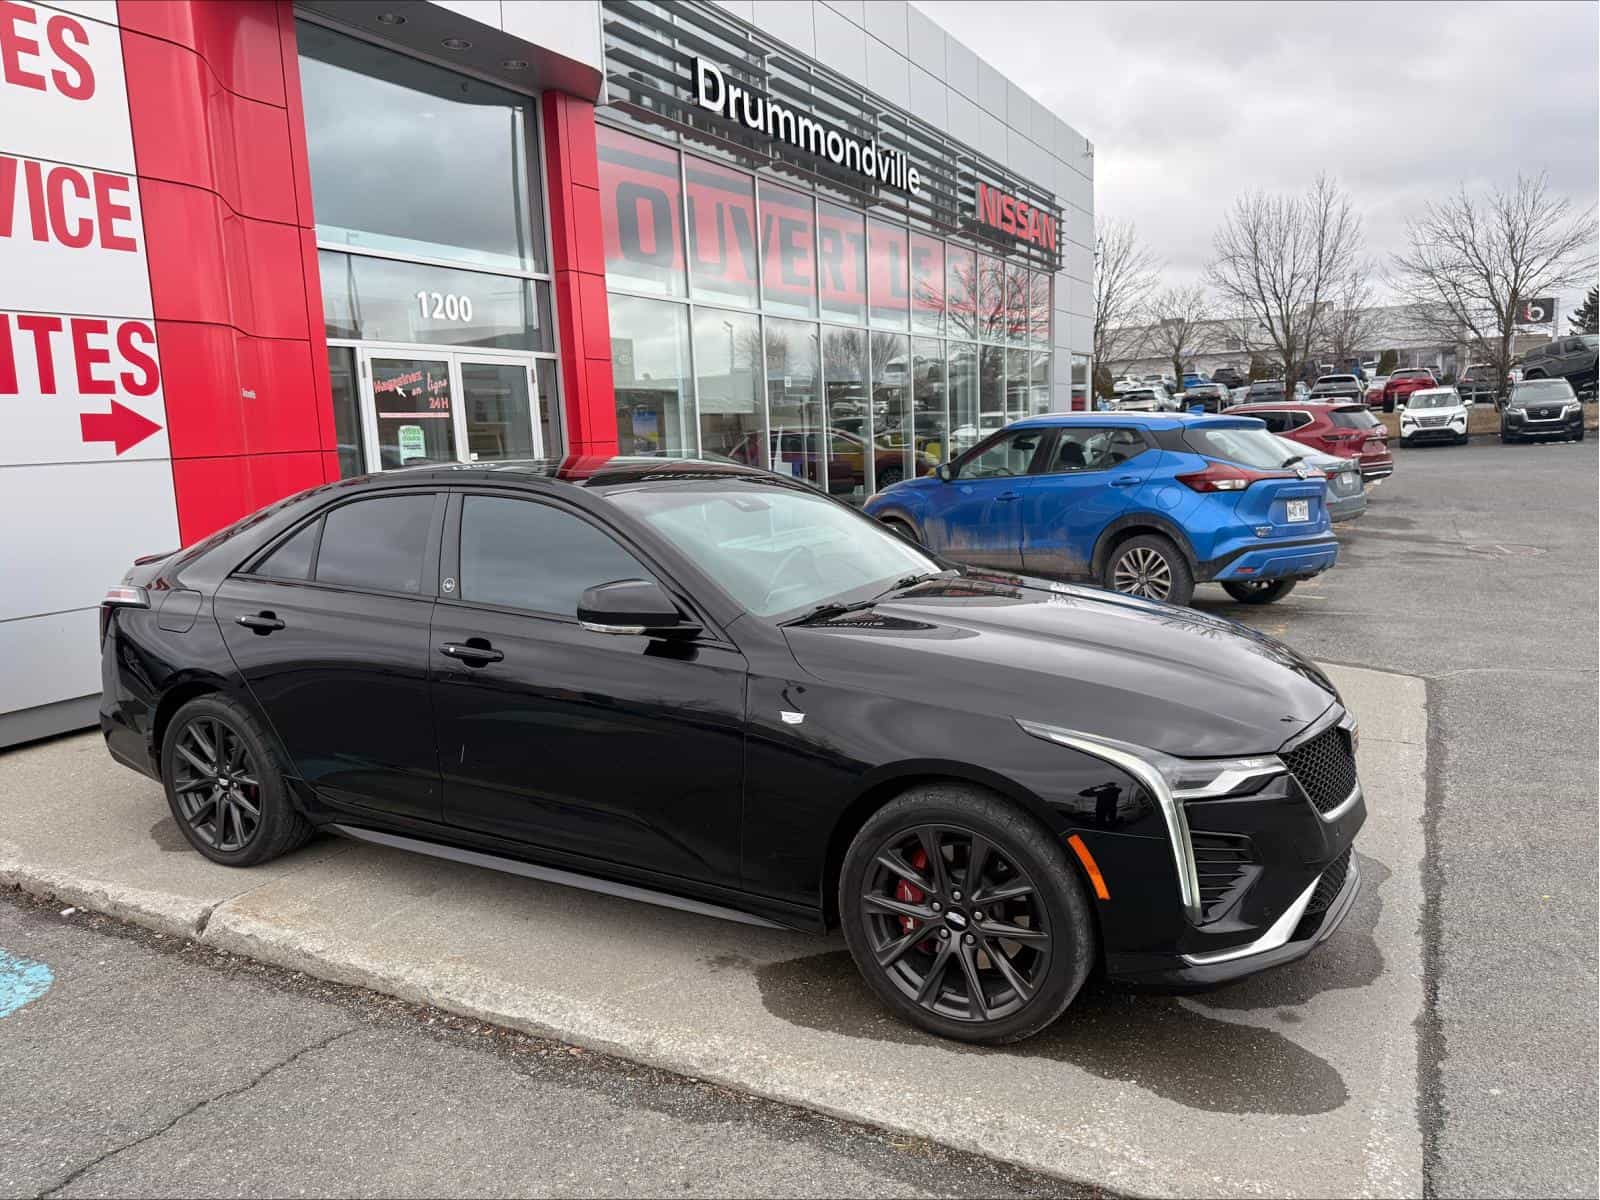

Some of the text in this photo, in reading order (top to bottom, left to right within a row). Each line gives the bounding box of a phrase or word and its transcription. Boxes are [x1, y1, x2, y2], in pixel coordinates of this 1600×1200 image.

[0, 1, 96, 101] ES
[692, 56, 921, 194] Drummondville
[616, 181, 873, 294] OUVERT
[976, 181, 1057, 252] NISSAN
[416, 290, 473, 322] 1200
